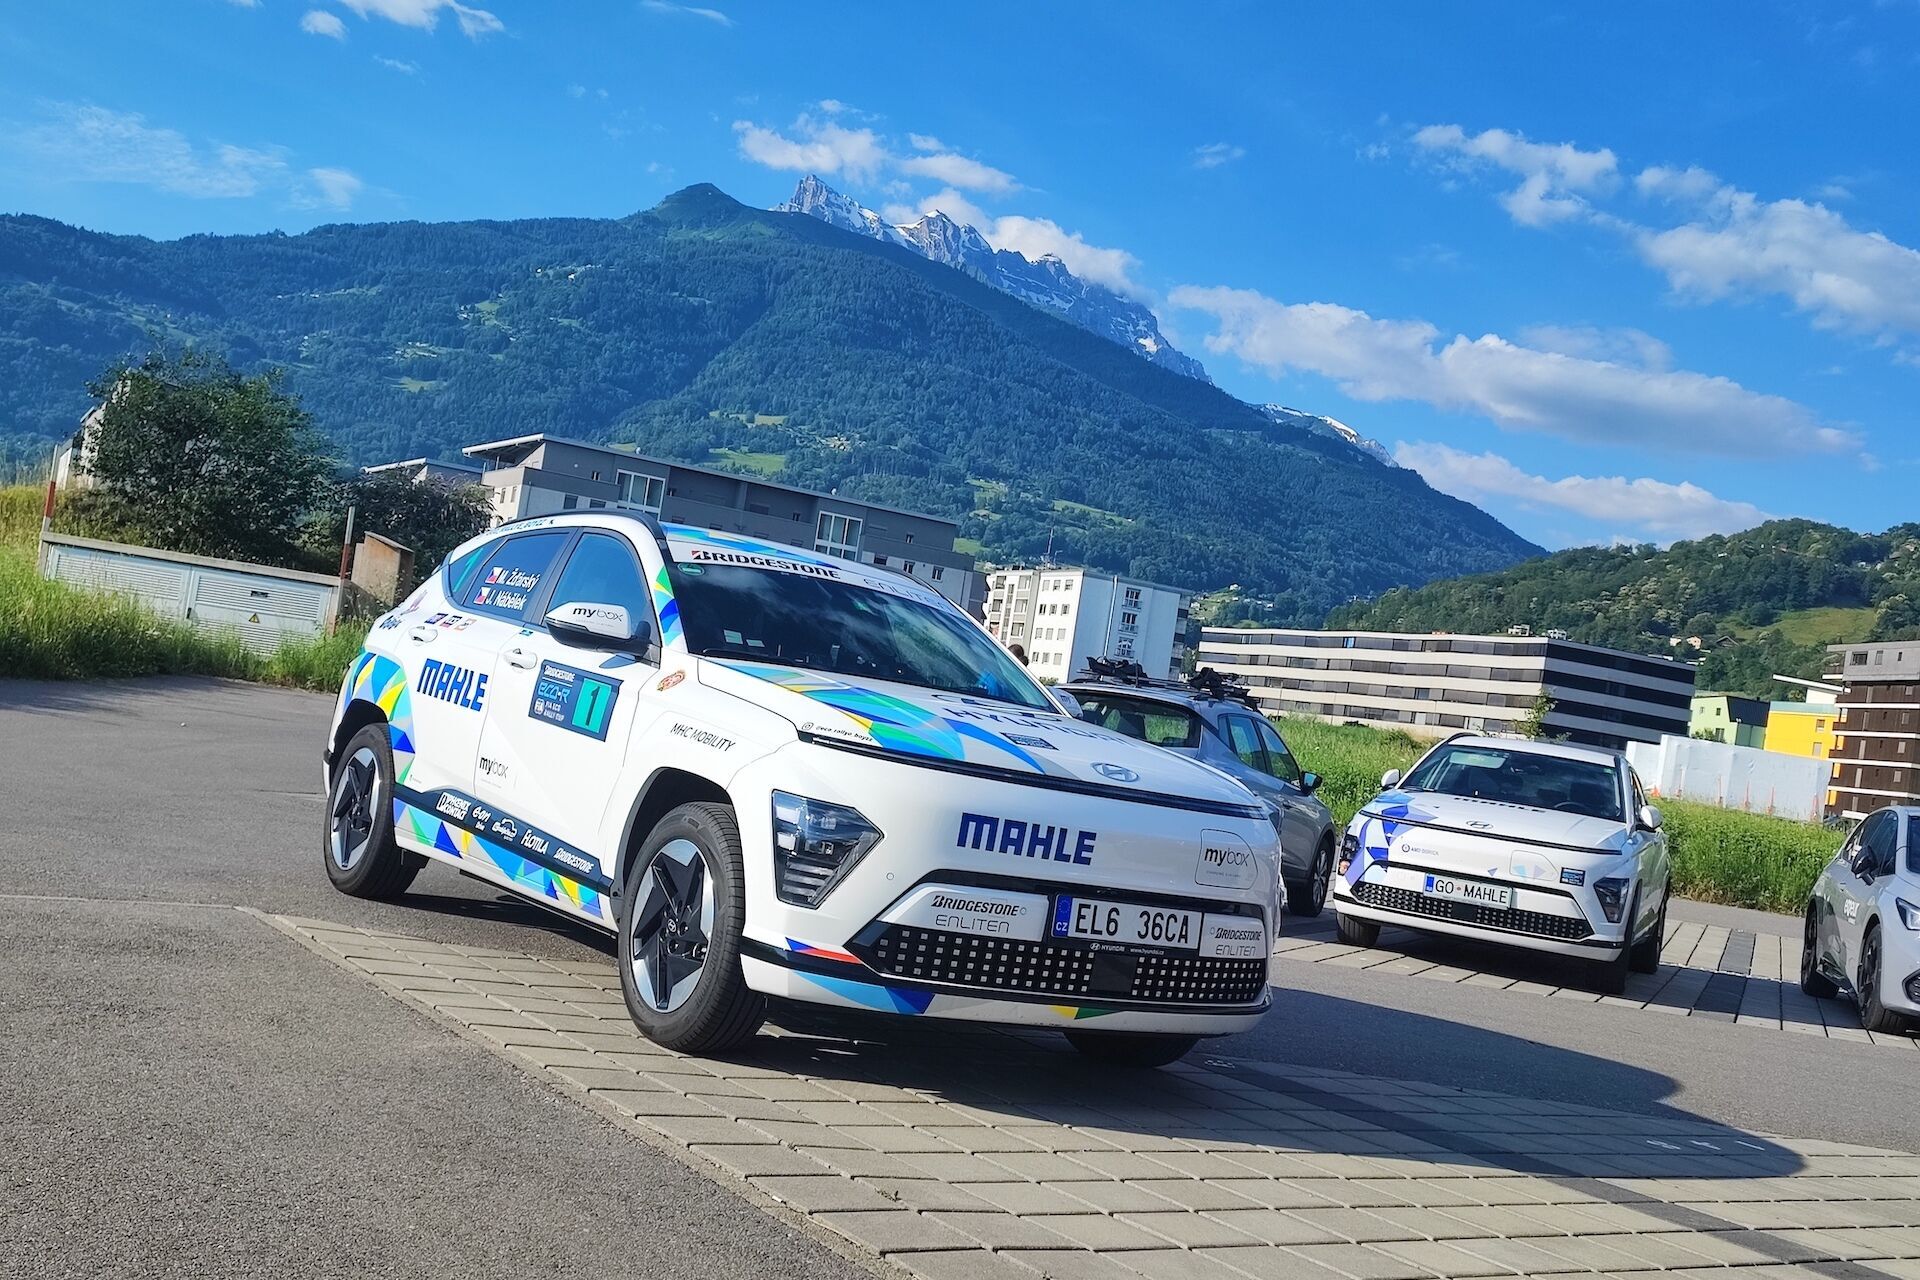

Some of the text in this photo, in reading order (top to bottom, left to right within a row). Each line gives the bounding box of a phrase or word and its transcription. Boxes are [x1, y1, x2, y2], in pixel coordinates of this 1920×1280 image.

[691, 550, 841, 579] BRIDGESTONE
[572, 607, 624, 622] mybox
[416, 657, 489, 713] MAHLE
[584, 685, 602, 727] 1
[670, 722, 737, 752] MHC MOBILITY
[479, 756, 509, 779] mybox
[957, 811, 1098, 866] MAHLE
[552, 846, 595, 874] BRIDGESTONE
[1204, 847, 1250, 868] mybox
[1435, 878, 1454, 894] GO
[1463, 883, 1508, 904] MAHLE
[930, 895, 1020, 917] BRIDGESTONE
[935, 914, 1010, 934] ENLITEN
[1055, 921, 1068, 932] CZ
[1074, 902, 1190, 945] EL6 36CA
[1214, 926, 1263, 941] BRIDGESTONE
[1100, 944, 1126, 953] HYUNDAI
[1215, 944, 1257, 957] ENLITEN
